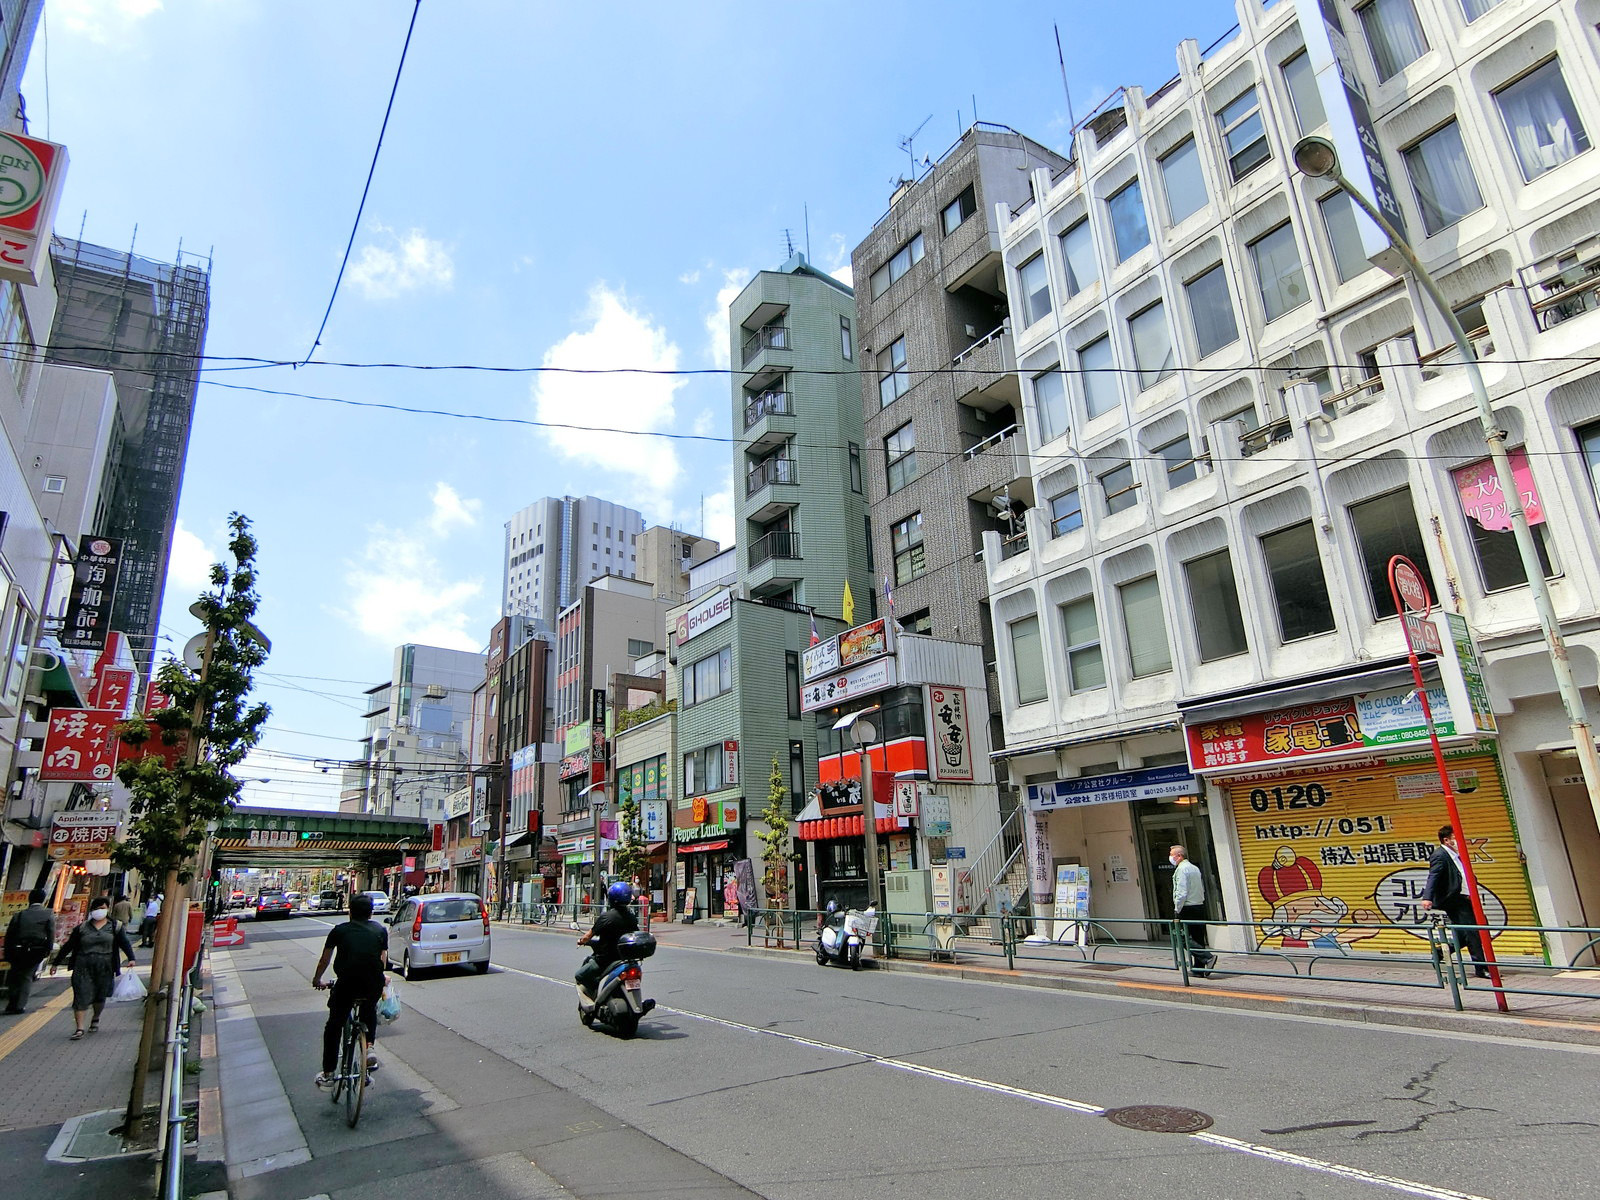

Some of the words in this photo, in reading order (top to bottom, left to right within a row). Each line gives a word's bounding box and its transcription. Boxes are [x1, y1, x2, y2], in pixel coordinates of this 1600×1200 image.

[0, 154, 31, 171] ON
[1357, 125, 1398, 217] 公営社
[1475, 475, 1508, 499] 大久
[1470, 491, 1537, 522] リラッス
[76, 630, 92, 638] B1
[934, 692, 943, 701] 2F
[1358, 701, 1373, 711] MB
[1201, 720, 1244, 740] 家電
[89, 723, 107, 762] ケナリ
[1202, 738, 1246, 755] 買います
[1204, 750, 1248, 766] 売ります
[95, 767, 109, 775] 2F
[1064, 795, 1092, 805] 公営社
[1094, 788, 1138, 802] お客様相談室
[55, 832, 67, 840] 2F
[71, 827, 108, 842] 焼肉
[674, 826, 699, 843] Pepper
[1391, 878, 1426, 899] コレ
